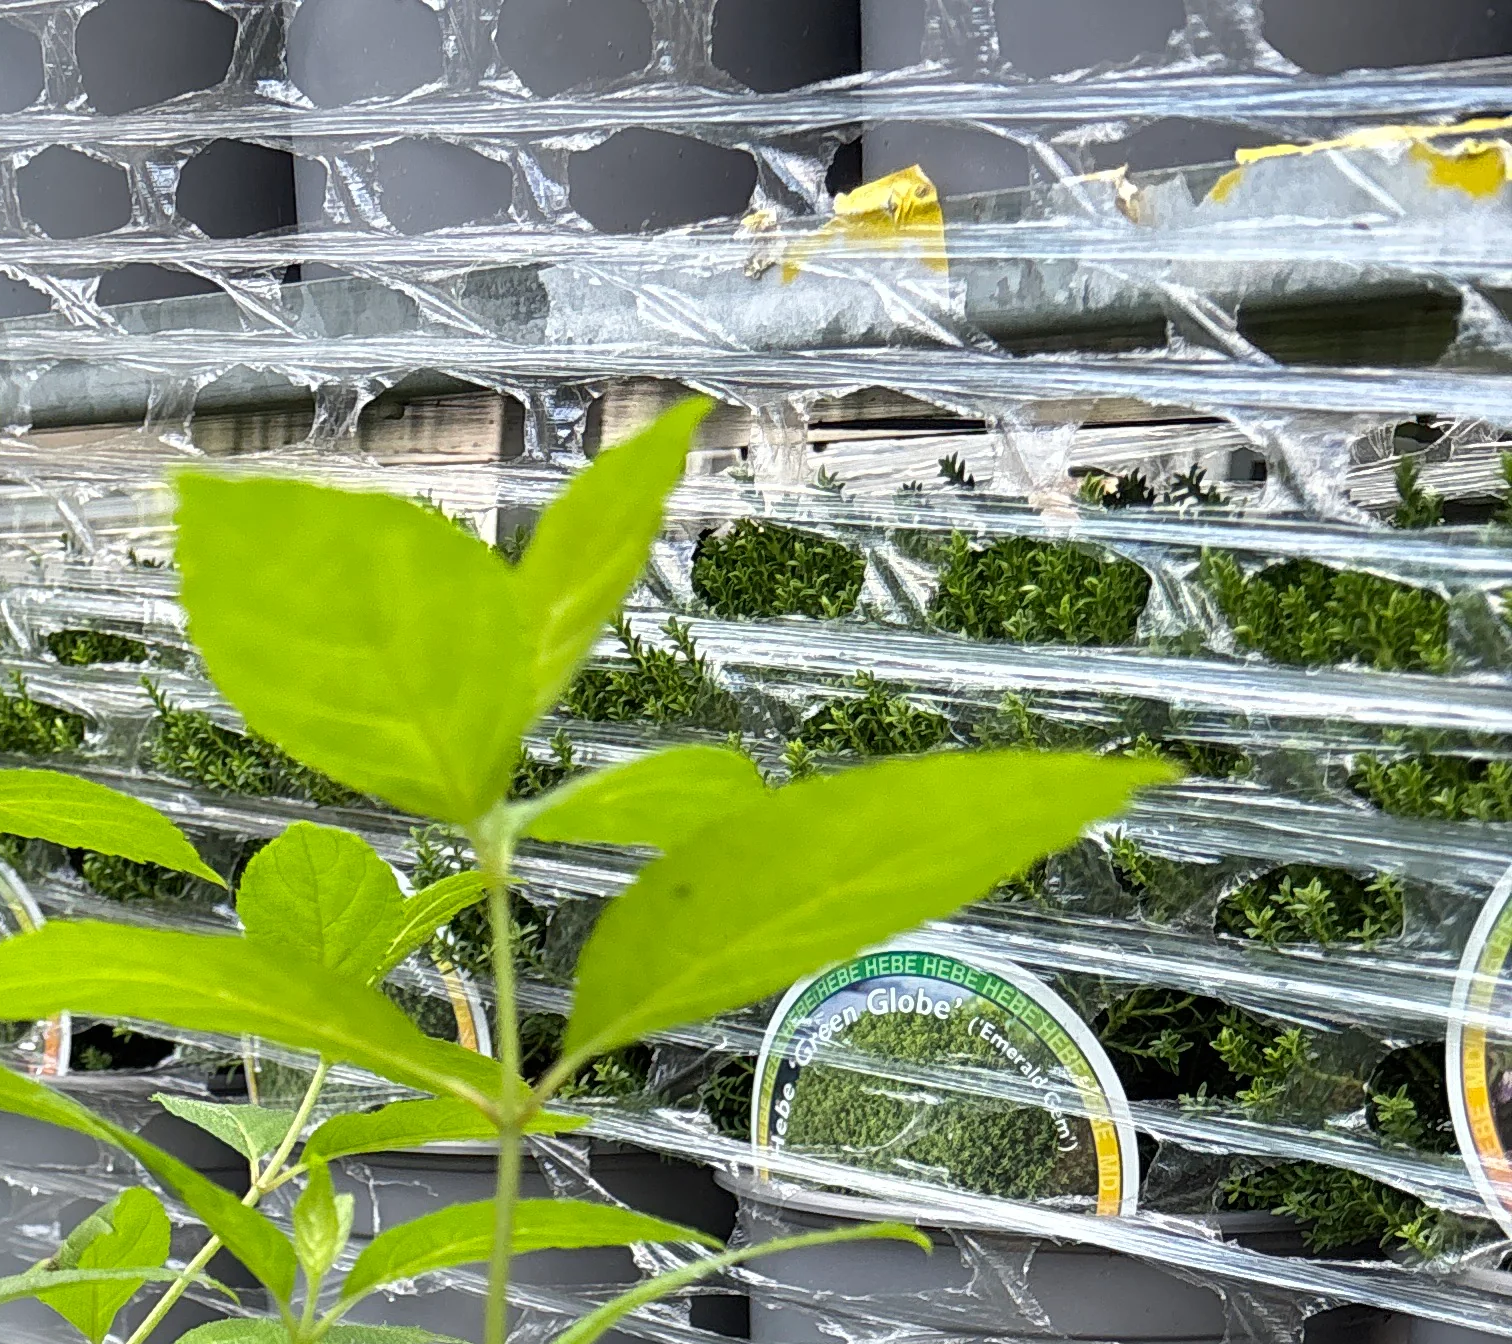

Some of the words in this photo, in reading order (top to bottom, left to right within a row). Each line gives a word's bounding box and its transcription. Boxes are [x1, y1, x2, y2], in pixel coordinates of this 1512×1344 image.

[816, 963, 863, 1001] HEBE
[865, 955, 918, 978] HEBE
[922, 955, 979, 990] HEBE
[981, 978, 1040, 1026] HEBE
[1037, 1012, 1090, 1078] HEBE
[867, 987, 963, 1020] Globe'
